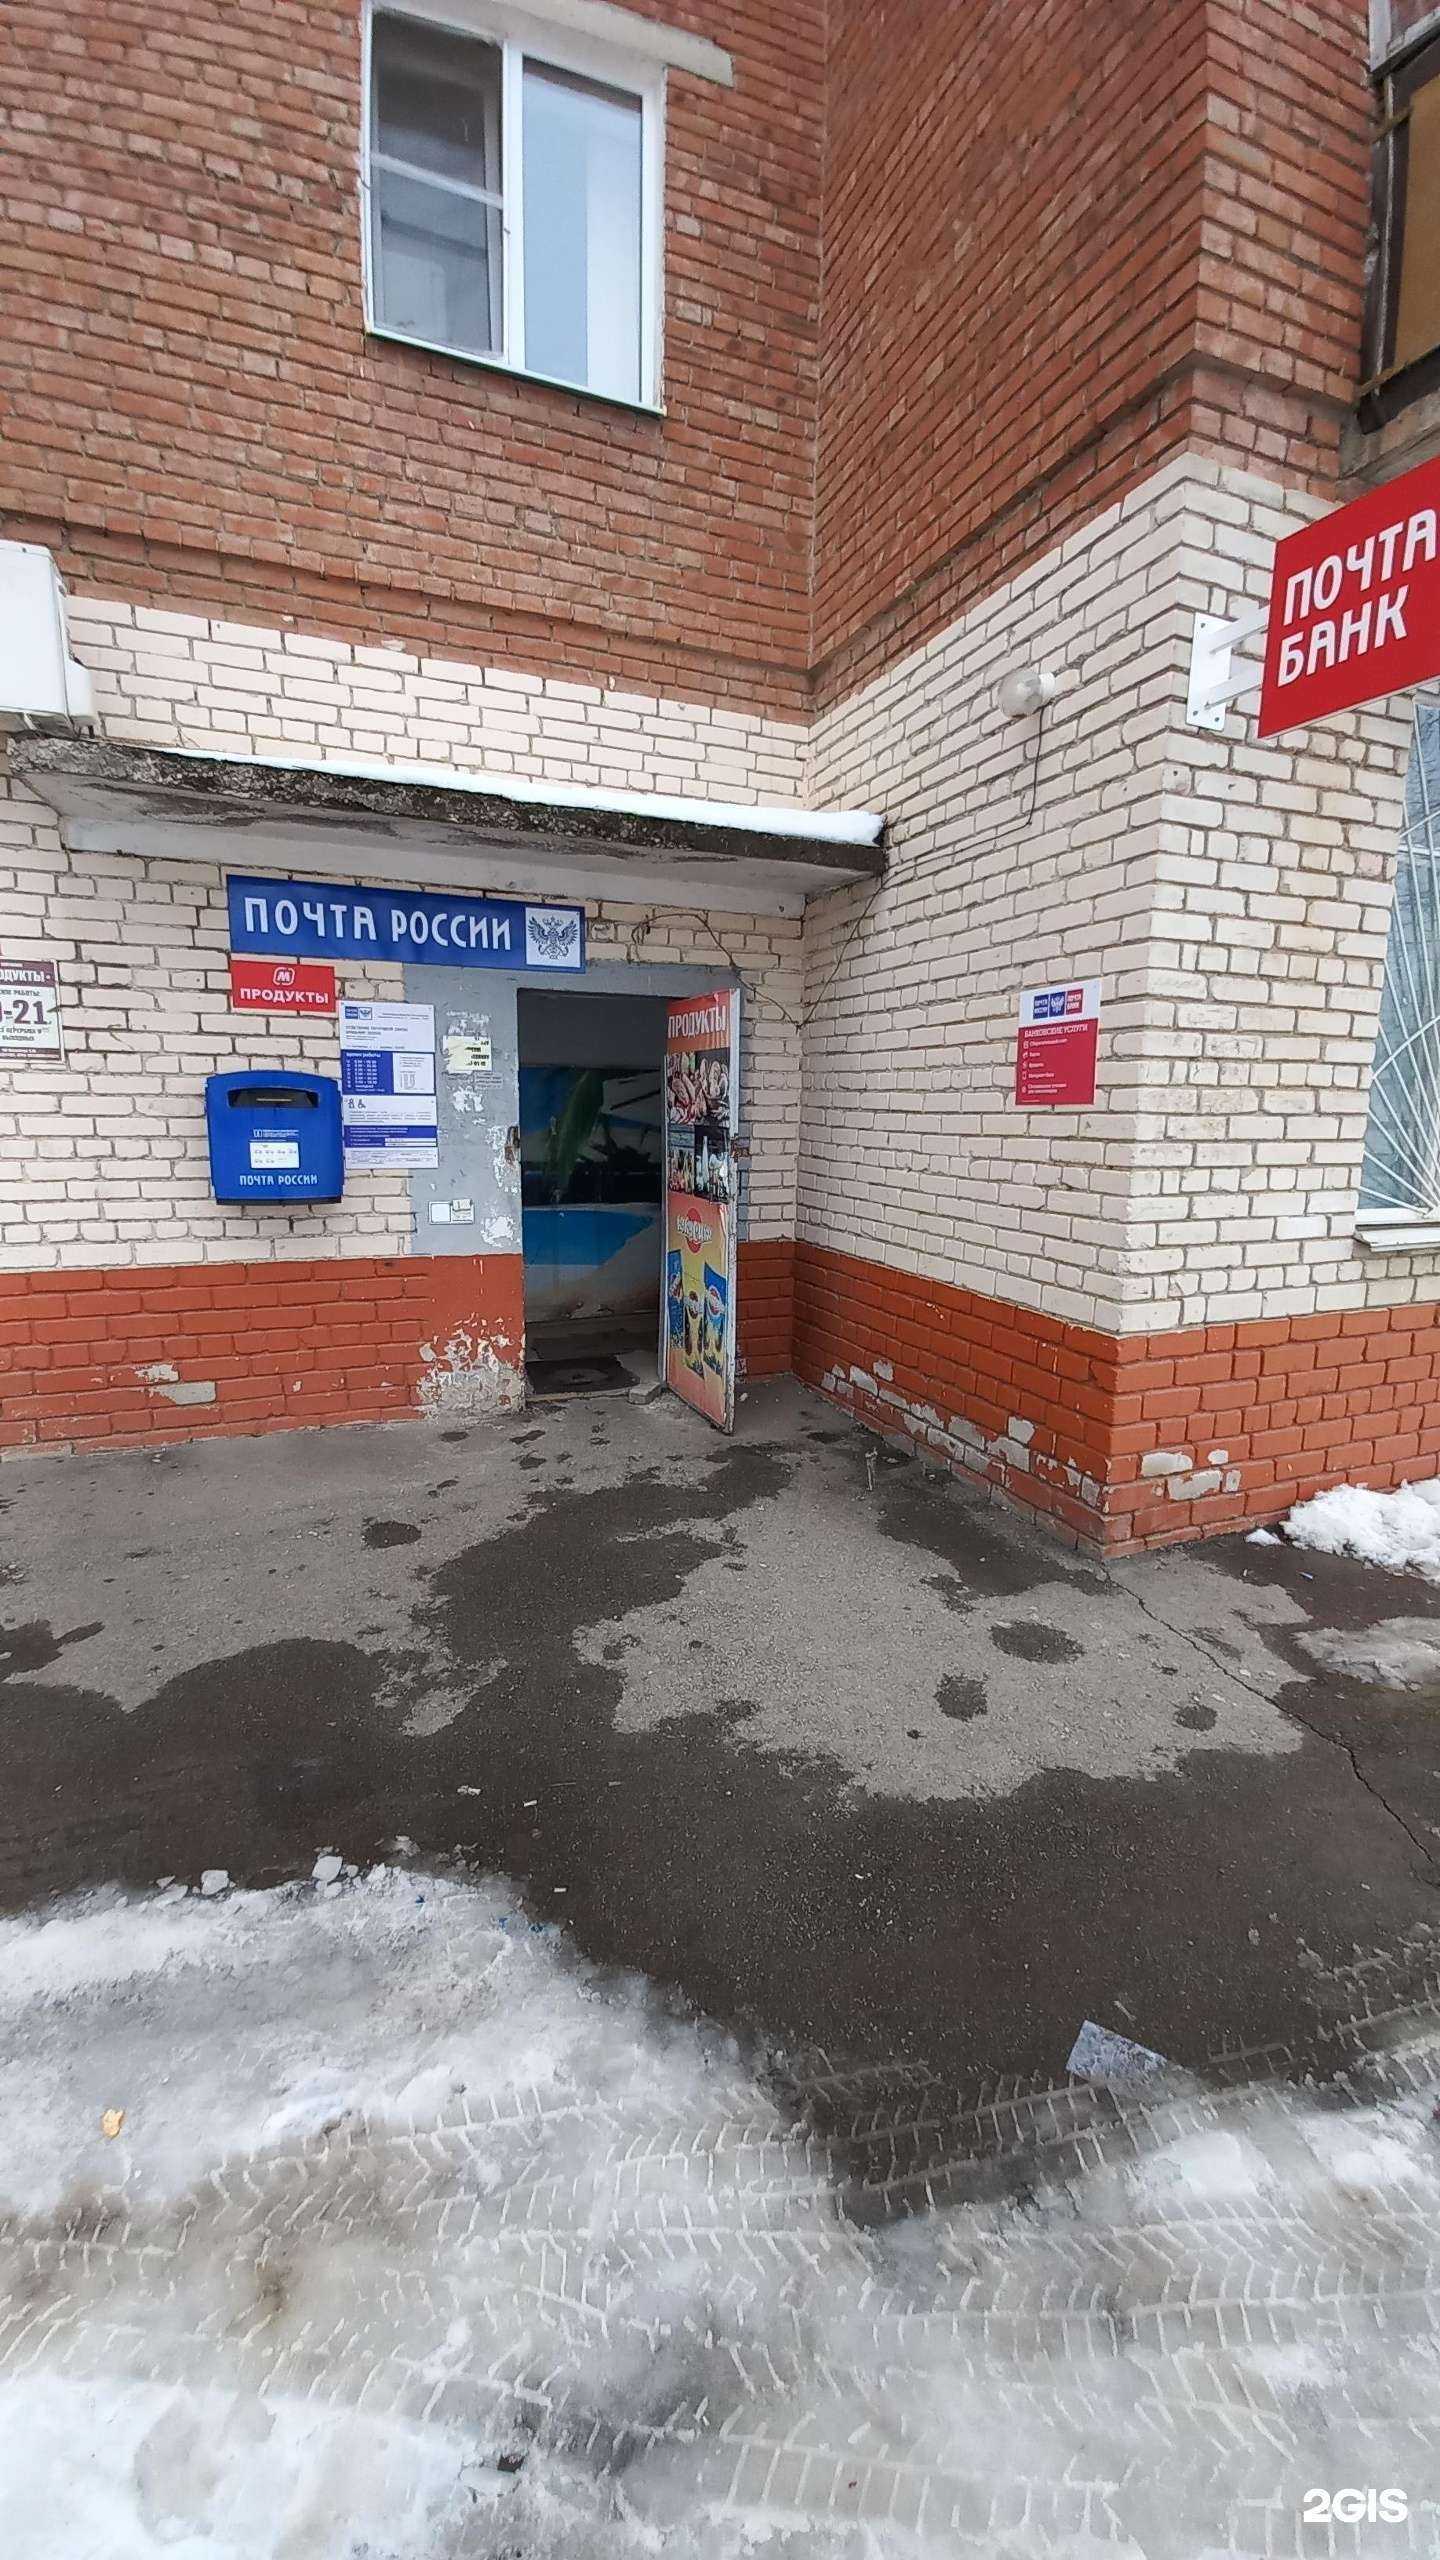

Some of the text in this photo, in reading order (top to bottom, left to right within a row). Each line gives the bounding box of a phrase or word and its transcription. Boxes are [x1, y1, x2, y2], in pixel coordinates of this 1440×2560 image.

[1282, 508, 1438, 626] ПОЧТА
[1276, 584, 1409, 688] БАНК
[244, 896, 512, 951] ПОЧТА РОССИИ
[240, 987, 329, 1005] ПРОДУКТЫ
[668, 1005, 727, 1039] ПРОДУКТЫ
[239, 1174, 318, 1186] ПОЧТА РОССИИ
